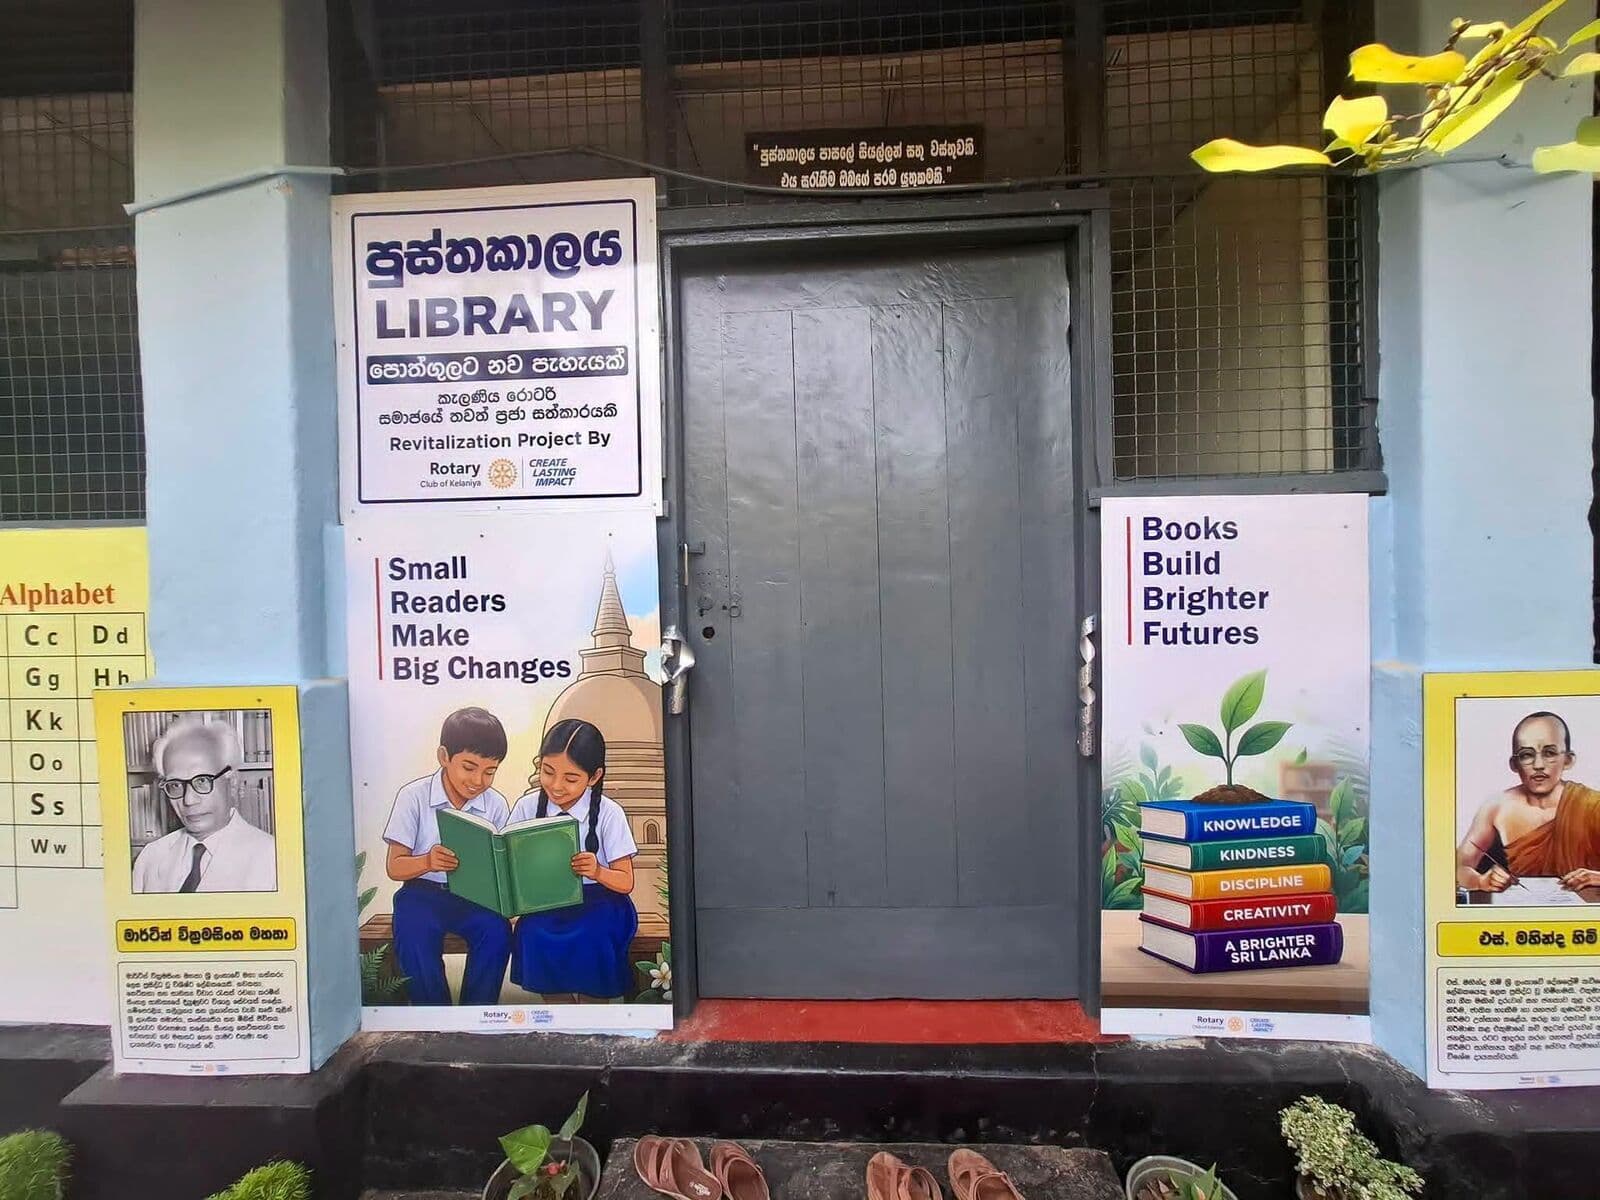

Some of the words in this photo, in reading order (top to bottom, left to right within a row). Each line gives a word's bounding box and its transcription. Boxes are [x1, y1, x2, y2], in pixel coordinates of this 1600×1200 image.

[819, 142, 855, 164] පාසලේ
[859, 141, 903, 163] සියල්ලන්
[906, 144, 925, 161] සතු
[781, 172, 798, 188] එය
[839, 169, 870, 188] ඔබගේ
[873, 168, 897, 186] පරම
[365, 228, 623, 289] පුස්තකාලය
[375, 289, 616, 340] LIBRARY
[369, 356, 480, 381] පොත්ගුලට
[487, 354, 523, 375] නව
[532, 348, 626, 373] පැහැයක්
[437, 389, 500, 407] කැලණිය
[506, 386, 557, 402] රොටරි
[379, 407, 444, 425] සමාජයේ
[450, 406, 489, 423] තවත්
[495, 406, 526, 425] ප්‍රජා
[532, 403, 618, 420] සත්කාරයකි
[390, 433, 512, 451] Revitalization
[518, 431, 582, 449] Project
[588, 430, 611, 447] By
[430, 461, 481, 477] Rotary
[529, 458, 568, 468] CREATE
[532, 467, 577, 477] LASTING
[420, 480, 438, 488] Club
[439, 479, 448, 488] of
[449, 478, 482, 488] Kelaniya
[535, 477, 575, 487] IMPACT
[1143, 516, 1239, 541] Books
[388, 555, 467, 581] Small
[1143, 551, 1220, 576] Build
[0, 582, 116, 611] Alphabet
[391, 589, 506, 614] Readers
[1143, 586, 1269, 616] Brighter
[392, 623, 470, 647] Make
[1143, 621, 1259, 645] Futures
[393, 657, 440, 685] Big
[448, 656, 571, 684] Changes
[1203, 815, 1302, 832] KNOWLEDGE
[1220, 846, 1295, 861] KINDNESS
[1220, 875, 1303, 891] DISCIPLINE
[1223, 904, 1311, 921] CREATIVITY
[124, 926, 172, 942] මාර්ටින්
[178, 926, 244, 944] වික්‍රමසිංහ
[250, 926, 288, 940] මහතා
[1225, 941, 1236, 952] A
[1240, 935, 1315, 951] BRIGHTER
[1479, 931, 1509, 946] එස්.
[1515, 931, 1566, 948] මහින්ද
[1571, 928, 1598, 945] හිමි
[1231, 951, 1255, 963] SRI
[1259, 947, 1312, 961] LANKA
[483, 1011, 509, 1019] Rotary
[1197, 1016, 1224, 1025] Rotary
